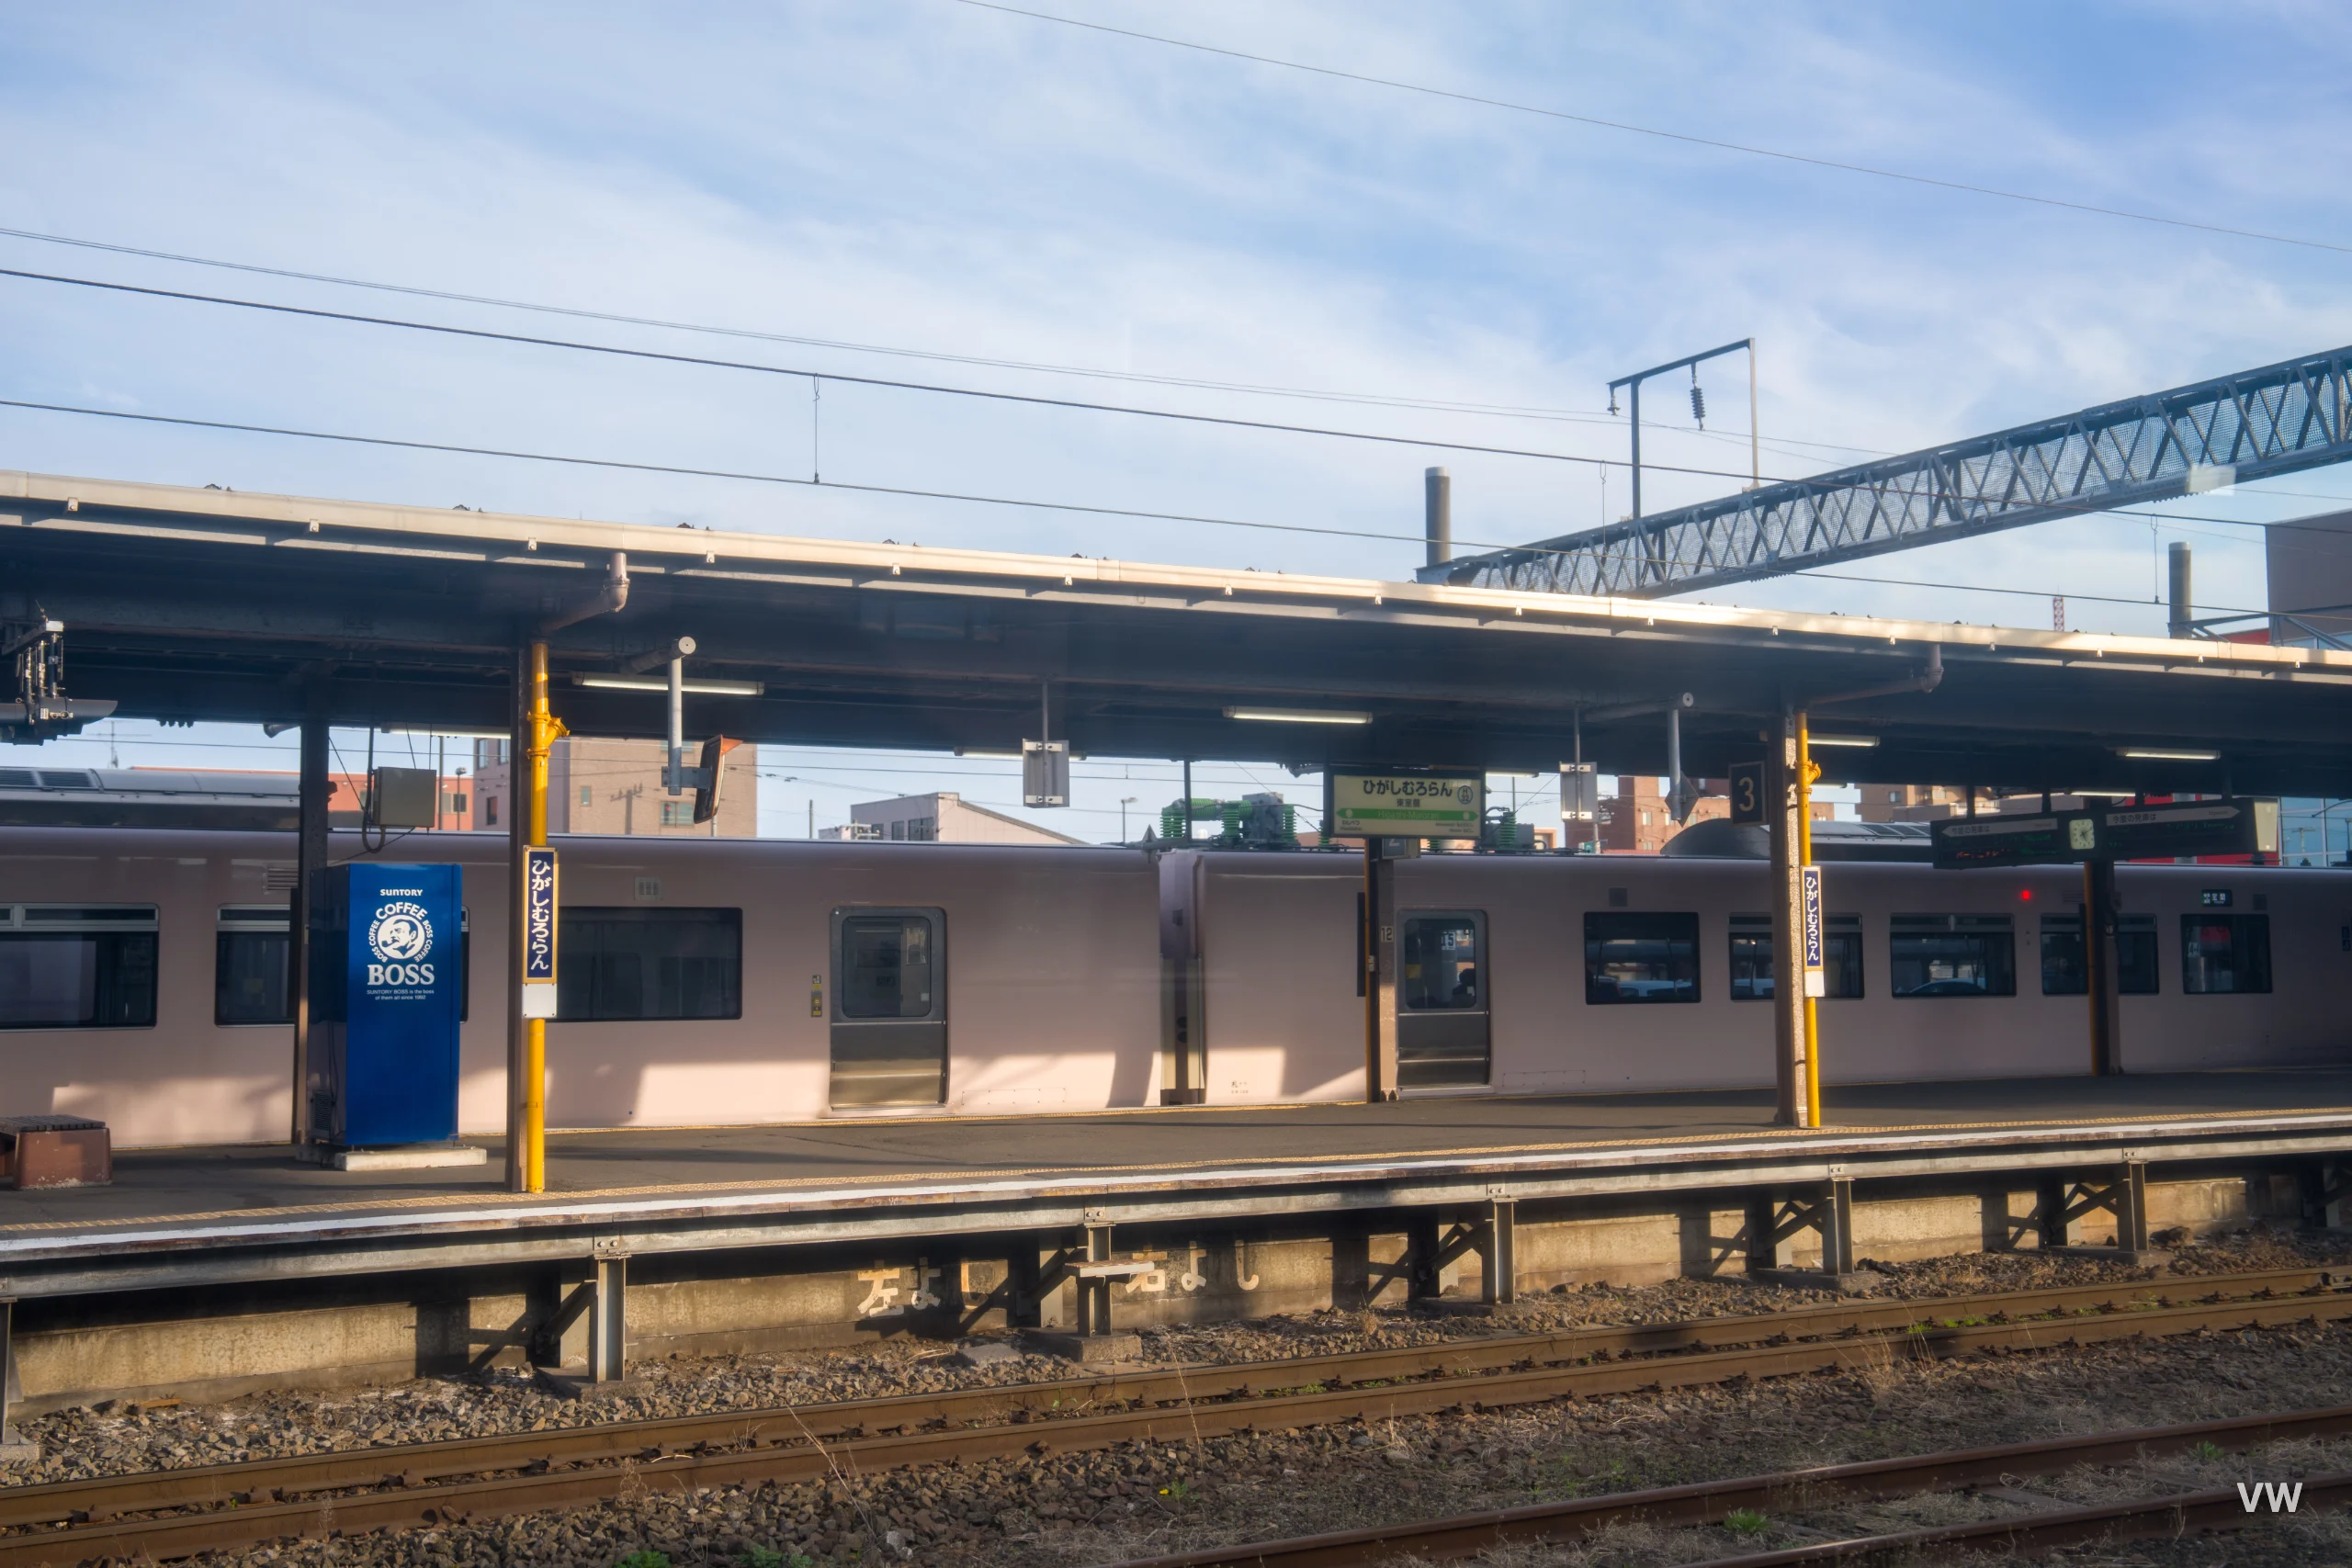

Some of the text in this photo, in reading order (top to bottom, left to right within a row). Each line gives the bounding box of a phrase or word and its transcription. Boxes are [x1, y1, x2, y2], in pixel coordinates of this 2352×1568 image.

[1363, 780, 1453, 797] ひがしむろらん
[1738, 776, 1755, 811] 3
[379, 888, 424, 897] SUNTORY
[375, 901, 428, 920] COFFEE
[530, 860, 550, 970] ひがしむろらん
[1805, 876, 1819, 962] ひがしむろらん
[368, 919, 389, 963] BOSS COFFEE
[413, 919, 434, 963] BOSS COFFEE
[1381, 927, 1392, 942] 12
[367, 964, 435, 986] BOSS
